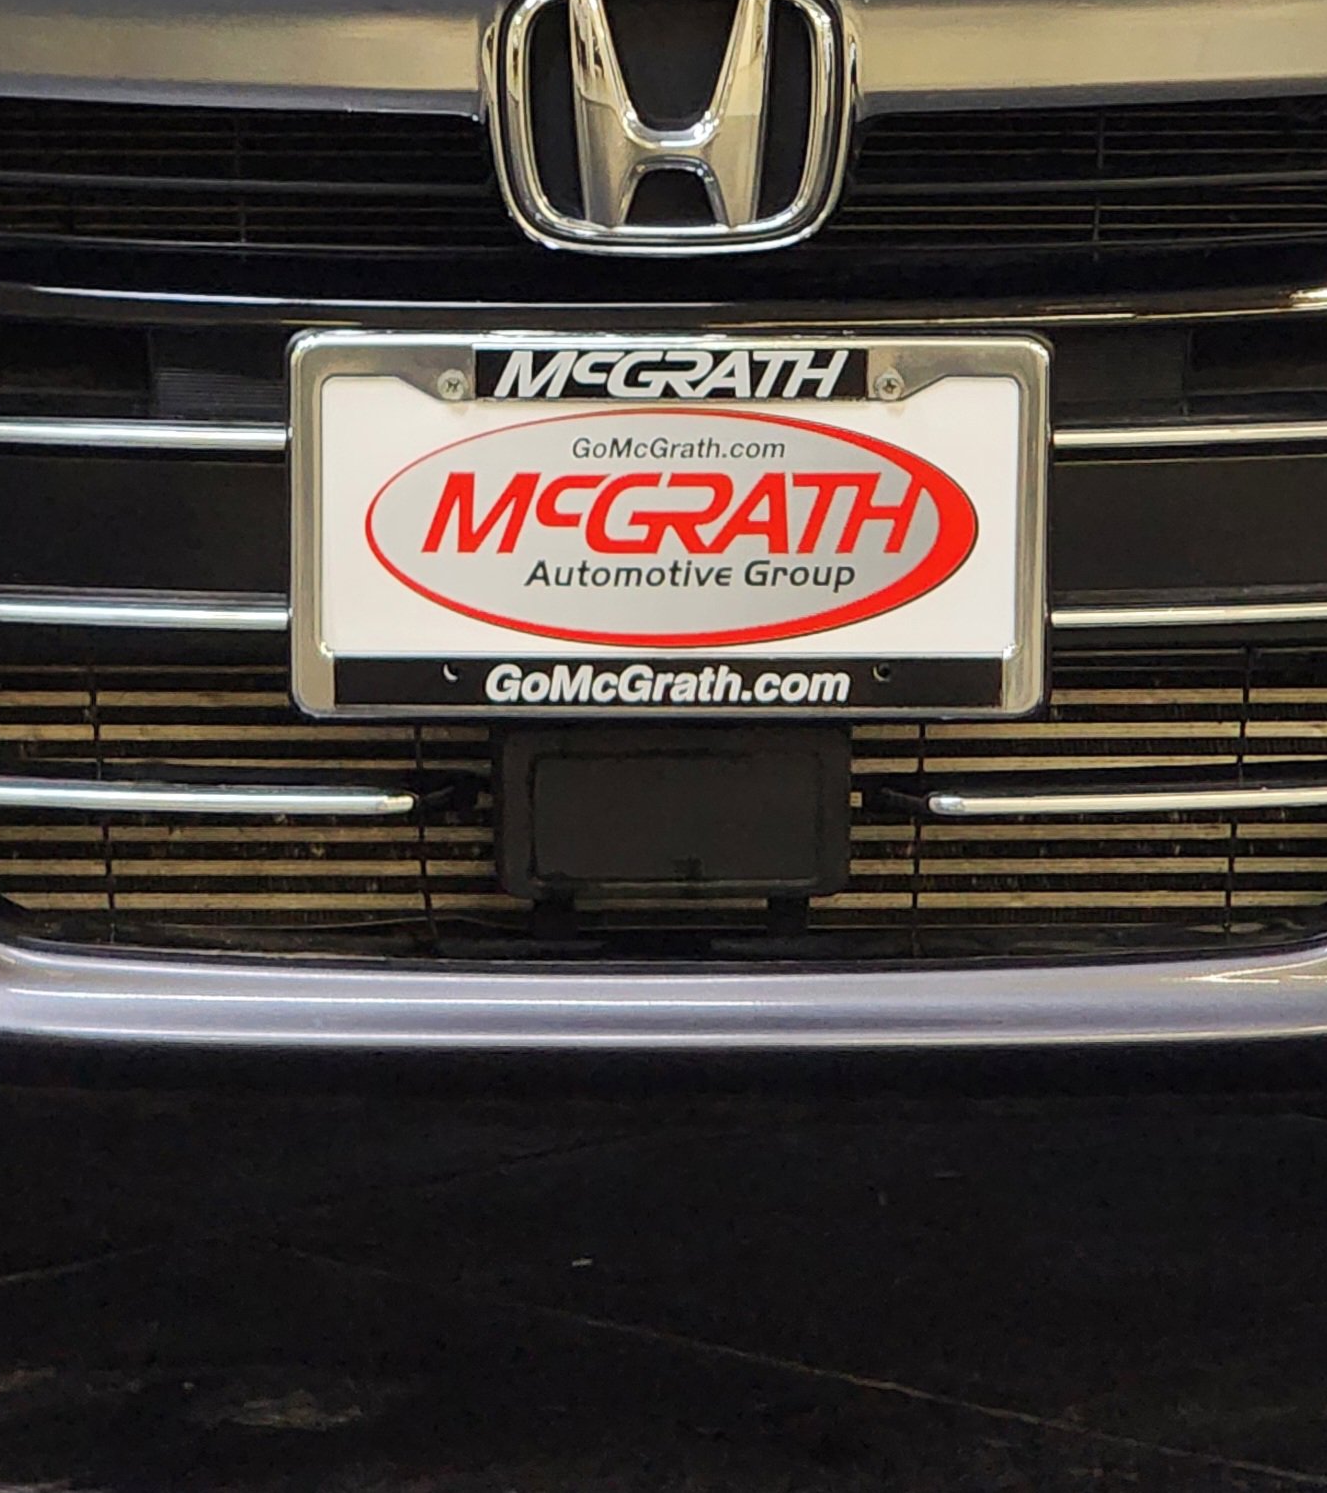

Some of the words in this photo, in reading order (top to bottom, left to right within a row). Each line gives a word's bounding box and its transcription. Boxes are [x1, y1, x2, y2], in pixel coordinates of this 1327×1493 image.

[571, 437, 786, 461] GoMcGrath.com
[524, 559, 732, 588] Automotive
[744, 561, 856, 593] Group
[485, 664, 851, 704] GoMcGrath.com
